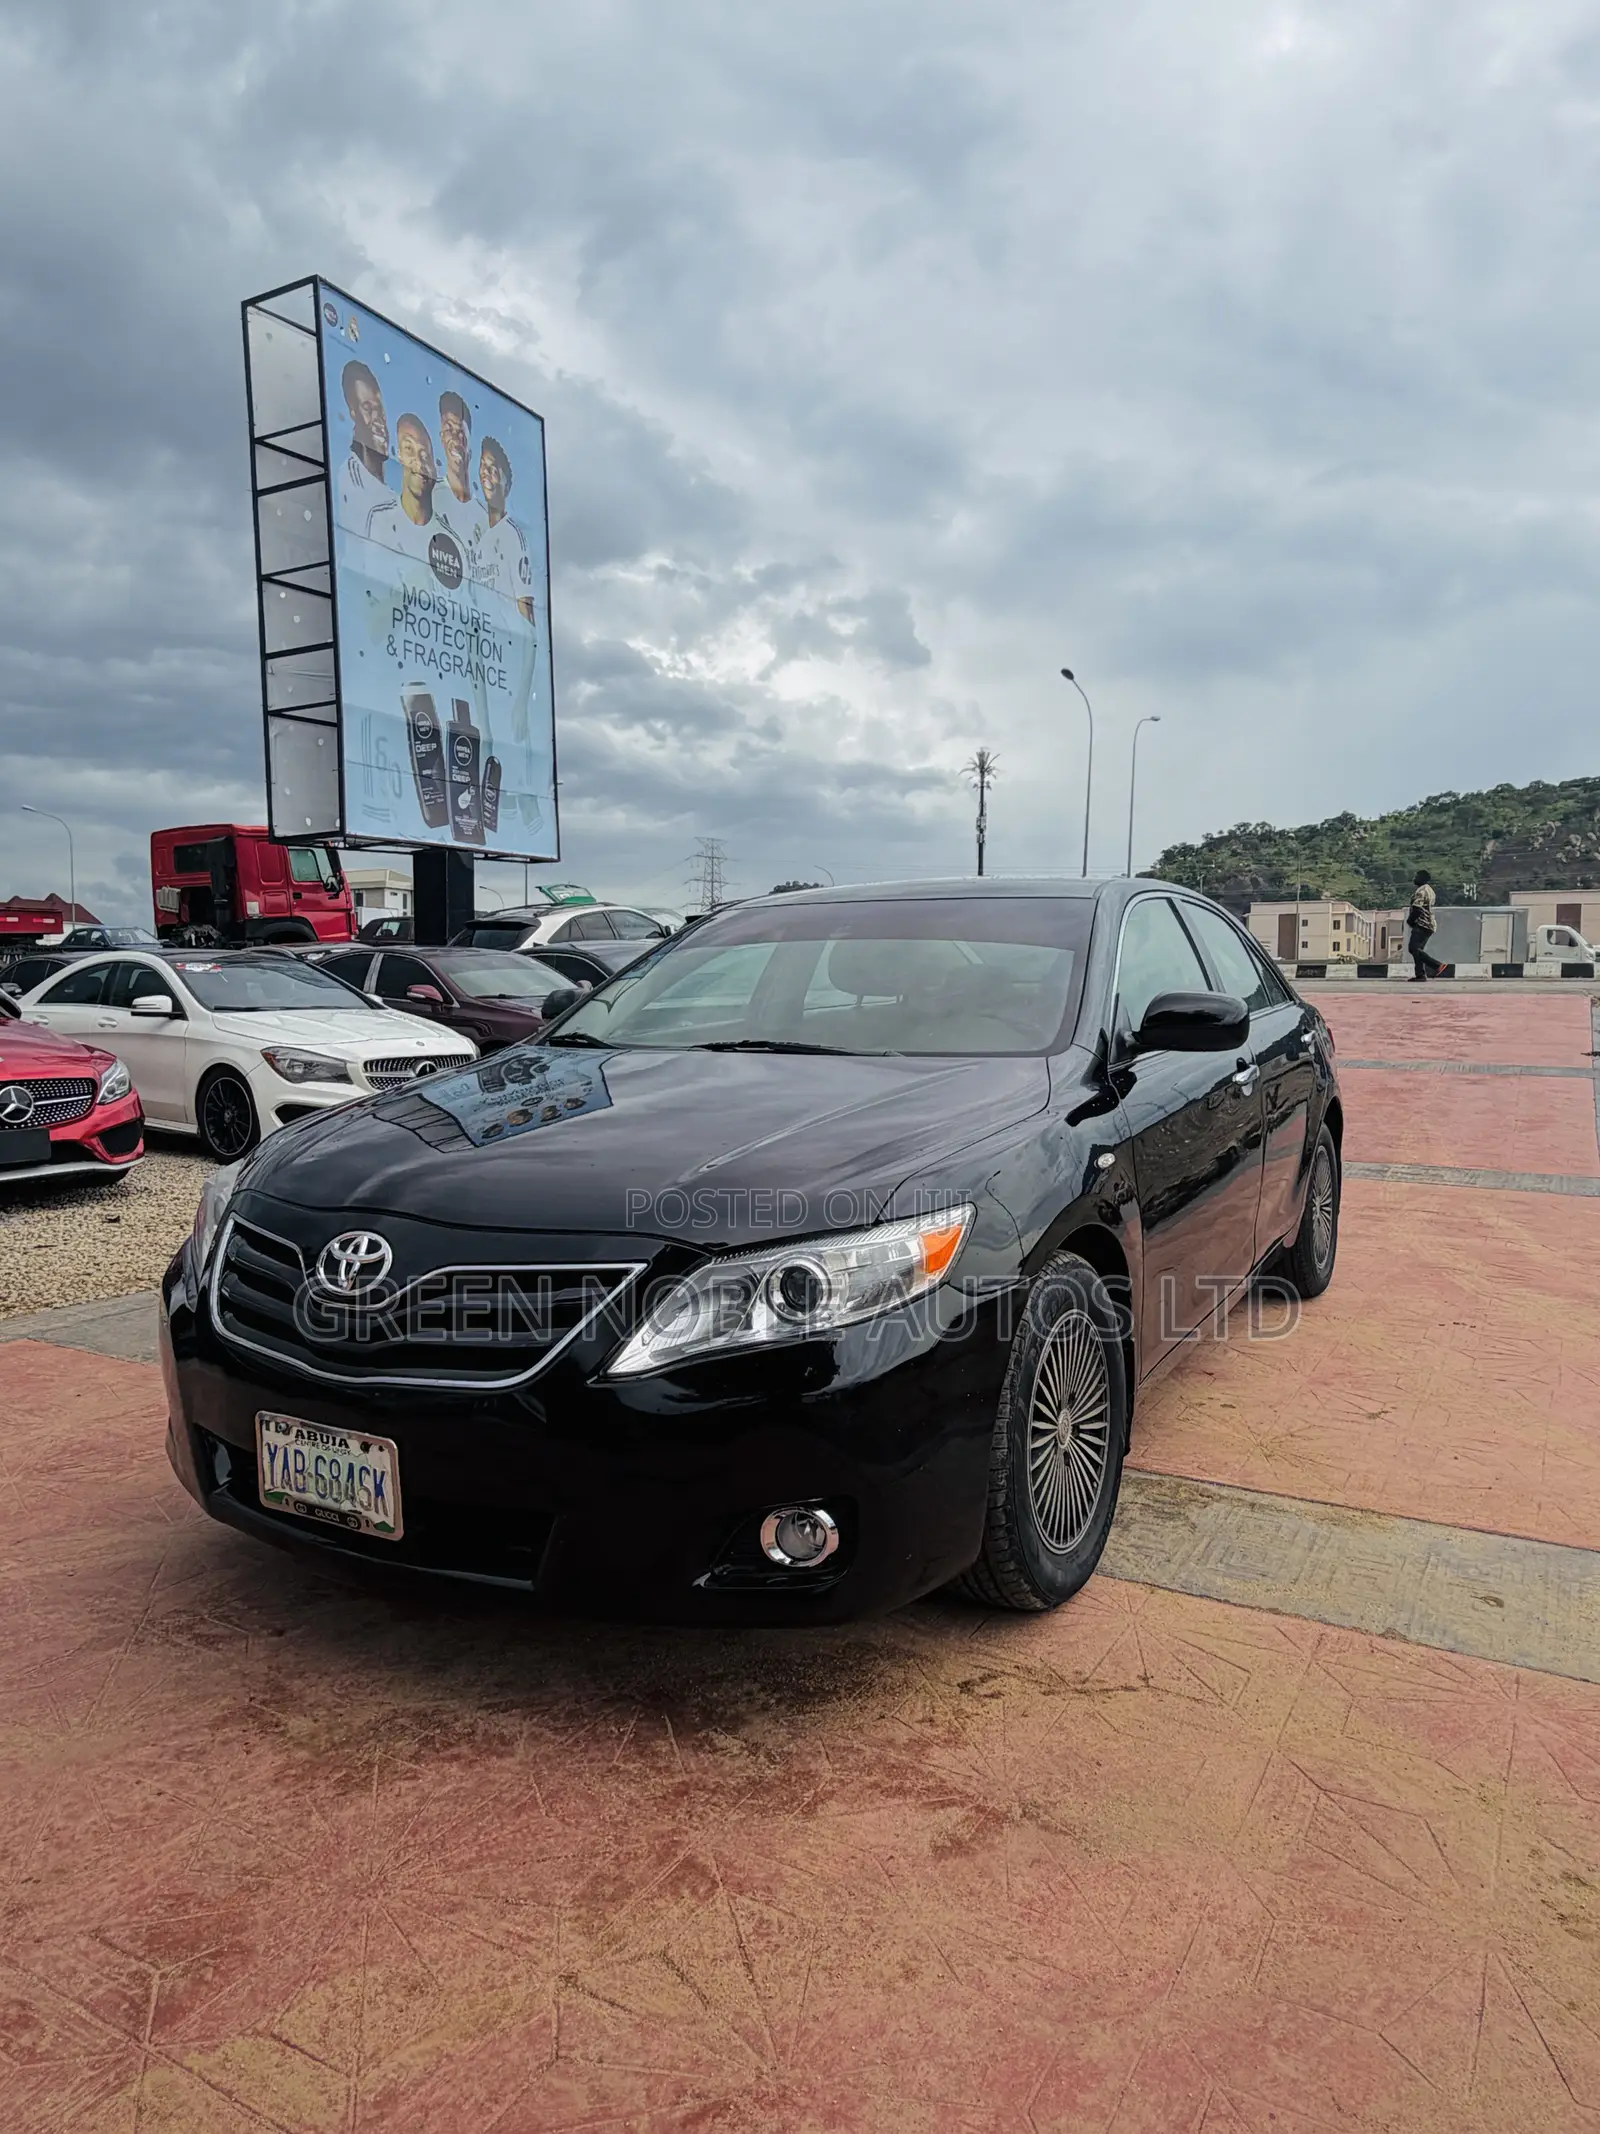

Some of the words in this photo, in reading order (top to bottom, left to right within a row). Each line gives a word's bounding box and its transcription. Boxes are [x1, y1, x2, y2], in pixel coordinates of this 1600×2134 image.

[432, 548, 460, 568] NIVEA
[436, 562, 458, 578] MEN
[402, 582, 496, 638] MOISTURE,
[392, 607, 503, 663] PROTECTION
[386, 634, 398, 658] &
[403, 639, 508, 691] FRAGRANCE
[415, 742, 437, 753] DEEP
[314, 1507, 340, 1523] GUCCI
